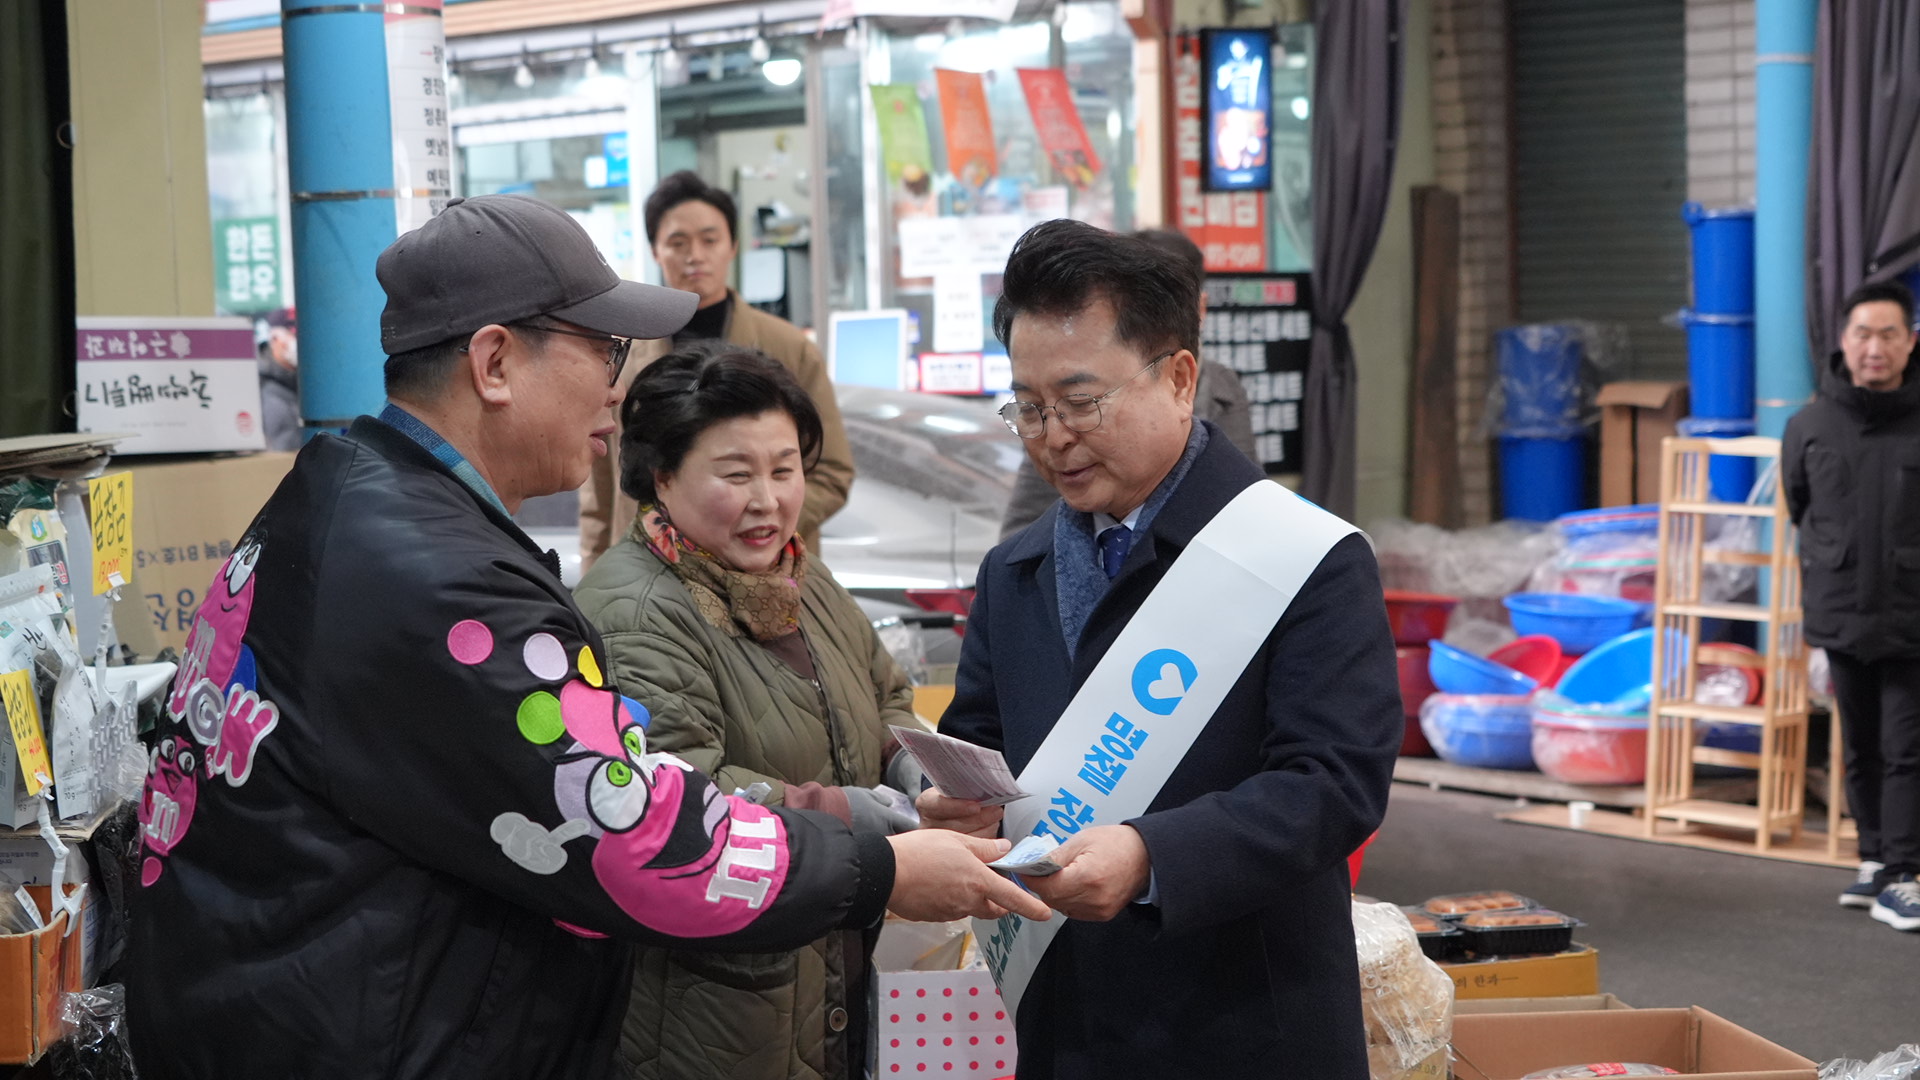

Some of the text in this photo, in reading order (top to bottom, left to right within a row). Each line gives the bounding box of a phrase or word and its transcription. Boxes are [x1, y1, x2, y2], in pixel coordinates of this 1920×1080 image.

[226, 224, 275, 263] 한돈
[228, 264, 277, 302] 한우
[1077, 711, 1150, 796] 명절
